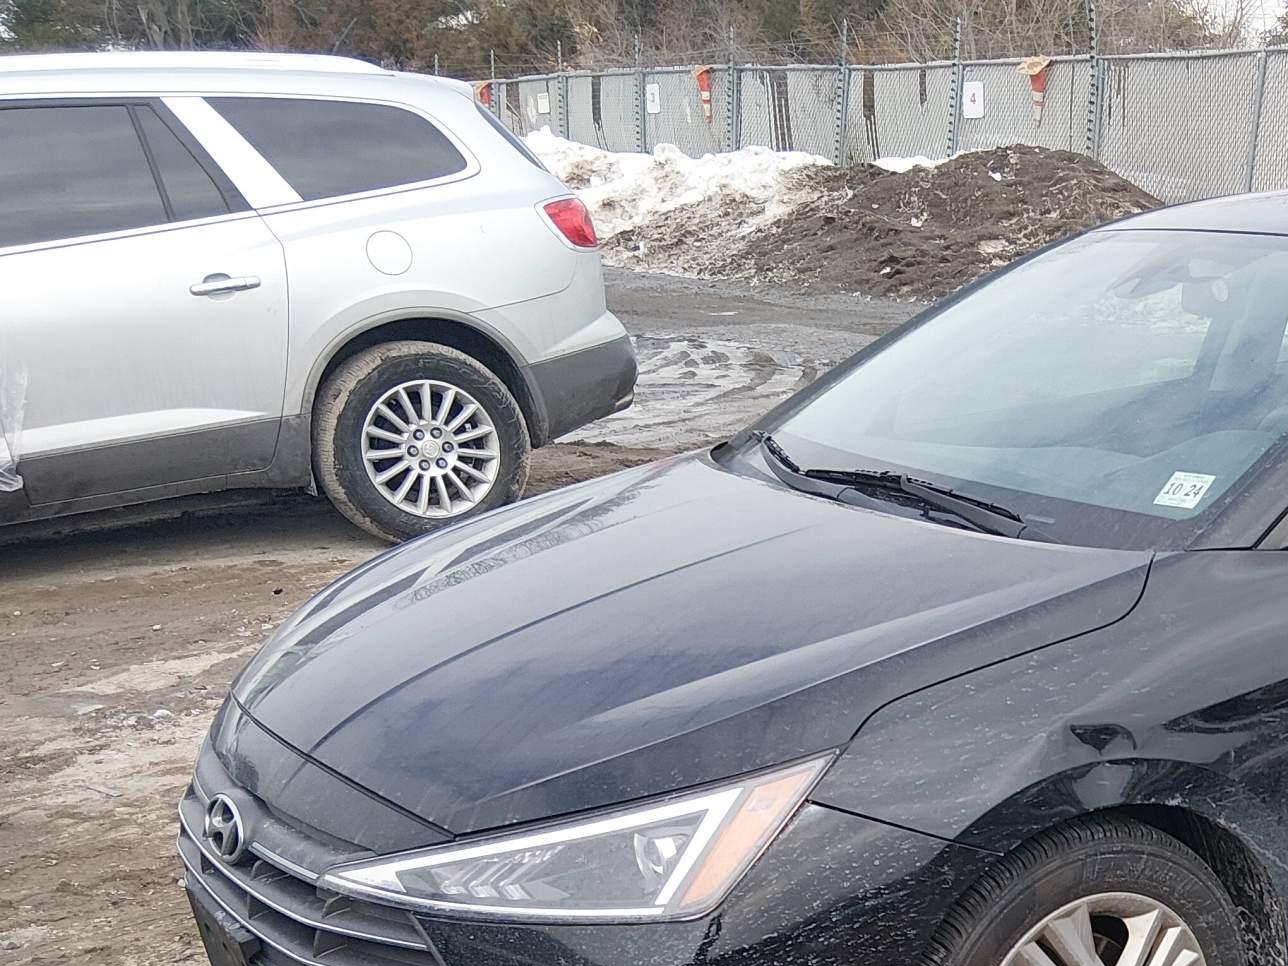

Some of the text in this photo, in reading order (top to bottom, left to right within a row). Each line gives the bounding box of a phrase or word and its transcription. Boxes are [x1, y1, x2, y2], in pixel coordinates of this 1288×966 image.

[970, 92, 977, 105] 4
[1163, 482, 1204, 498] 10 24
